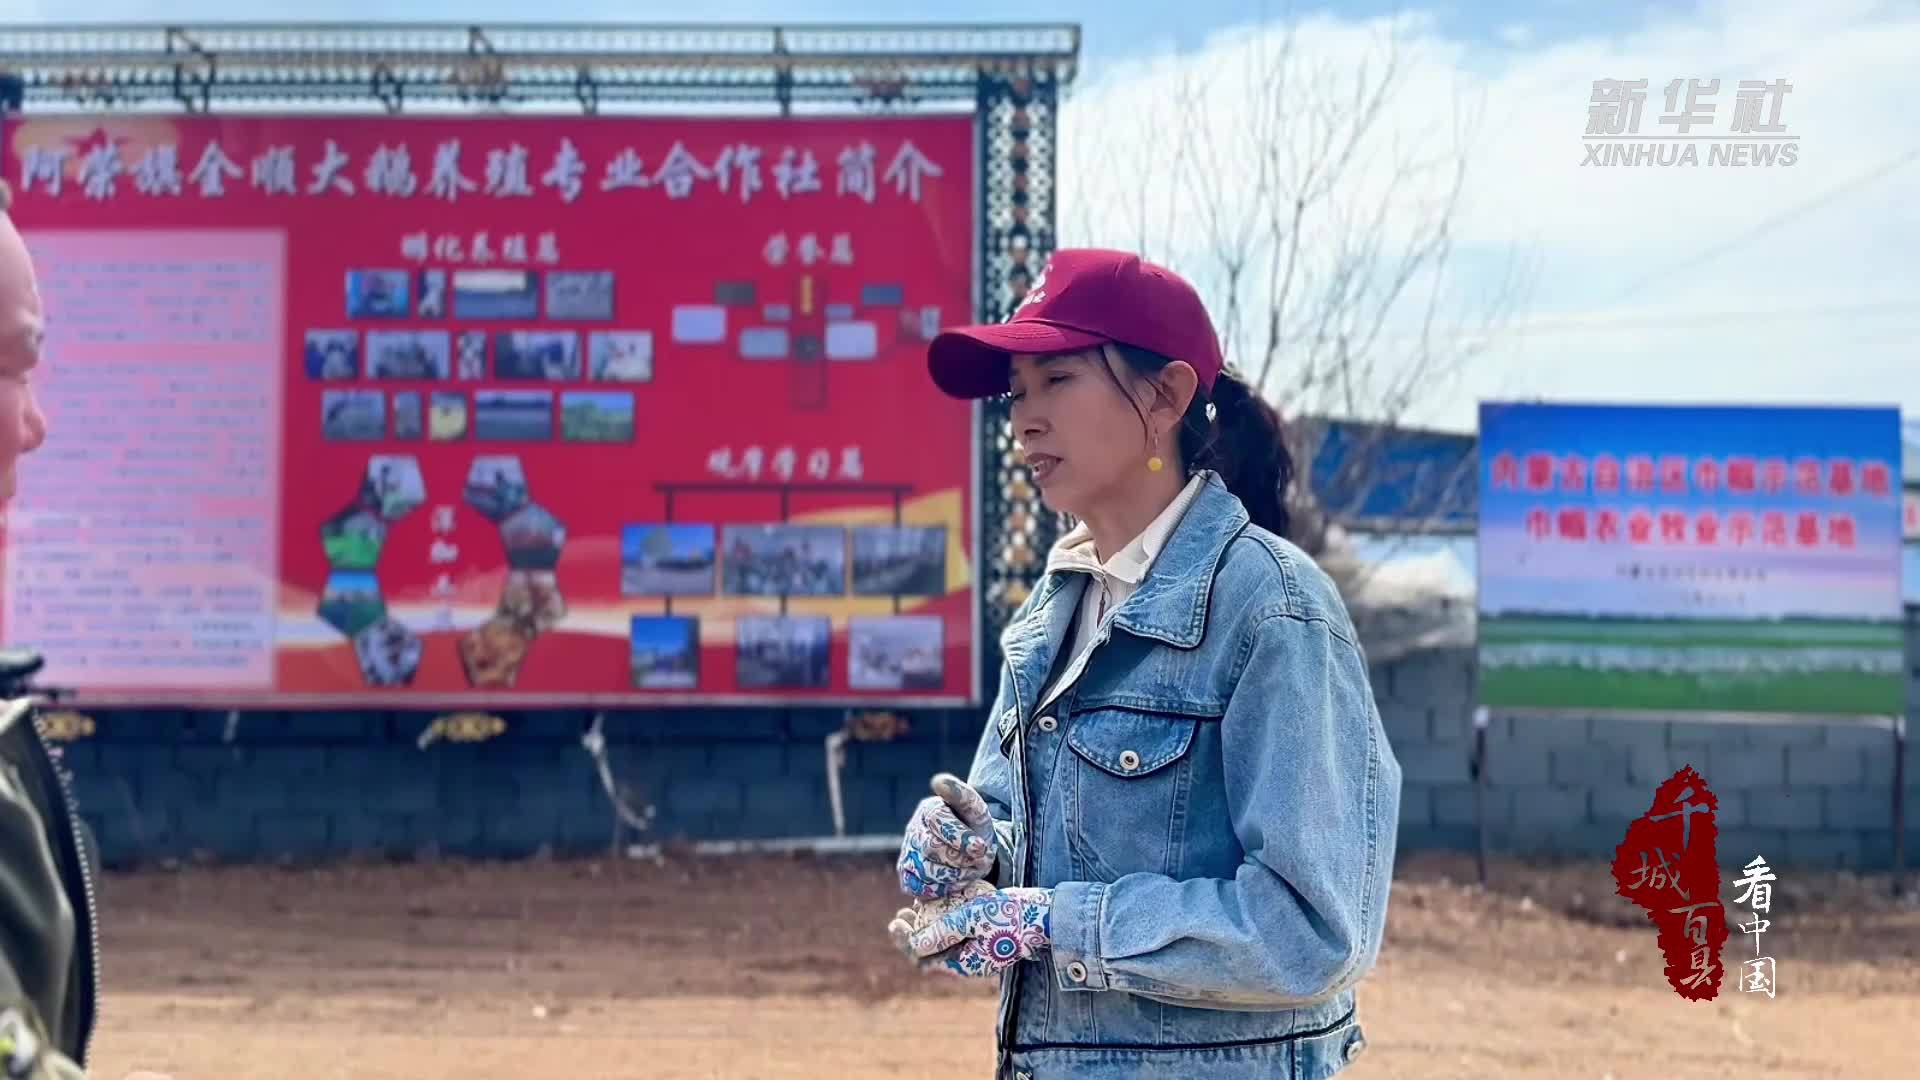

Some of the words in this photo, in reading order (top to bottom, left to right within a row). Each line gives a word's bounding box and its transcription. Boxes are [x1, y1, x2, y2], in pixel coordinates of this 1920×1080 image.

[20, 138, 943, 203] 阿荣旗金顺大鹅养殖专业合作社简介
